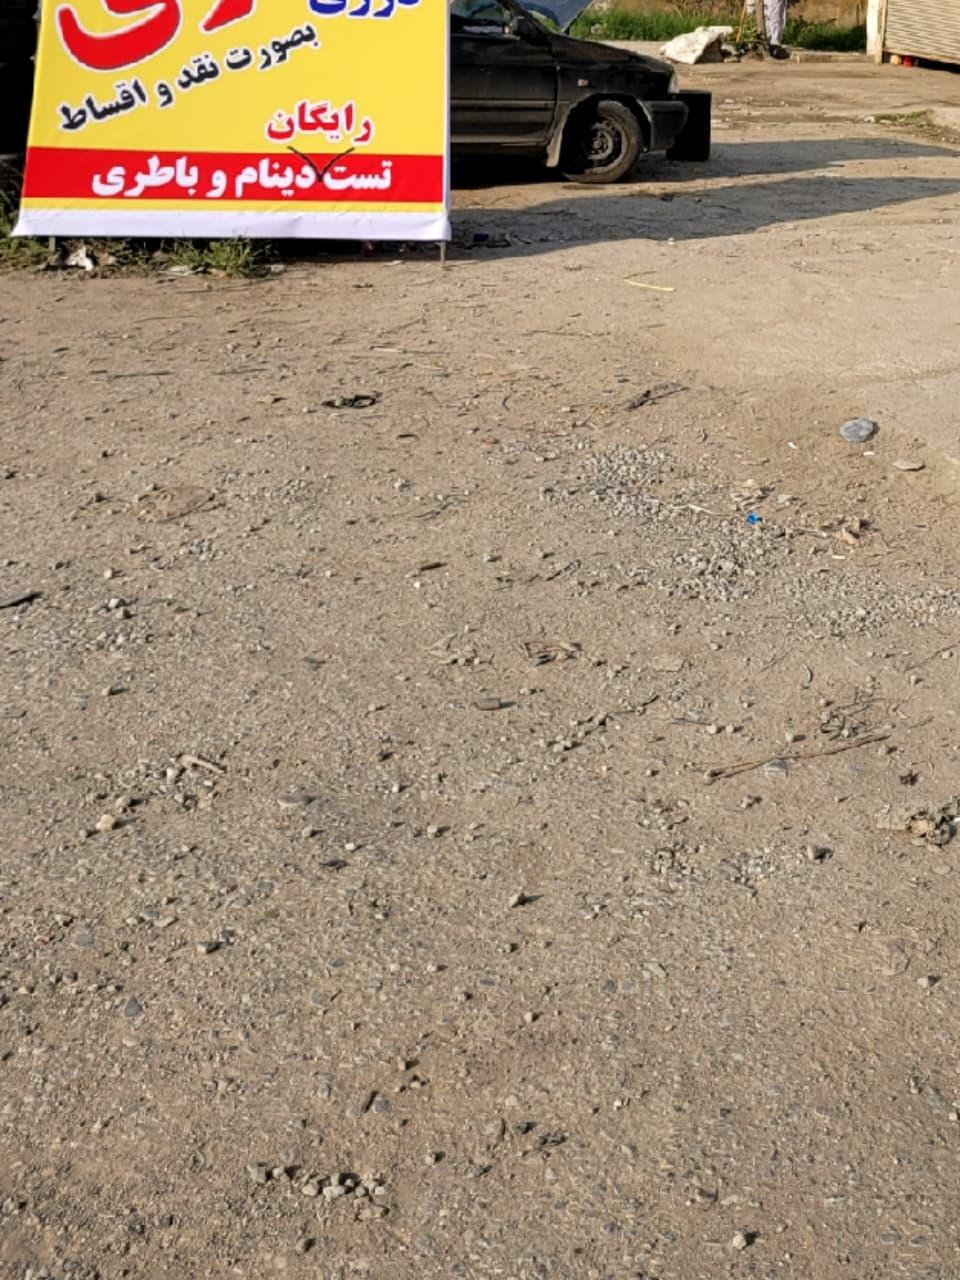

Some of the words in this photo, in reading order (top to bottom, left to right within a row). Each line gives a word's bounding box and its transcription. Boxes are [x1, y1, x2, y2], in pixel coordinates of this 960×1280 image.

[225, 23, 319, 70] بصورت
[177, 54, 219, 90] نقد
[59, 79, 147, 131] اقساط
[156, 82, 173, 107] و
[266, 102, 372, 142] رایگان
[92, 156, 198, 198] باطری
[206, 168, 227, 198] و
[235, 158, 317, 198] دینام
[322, 160, 392, 191] تست
